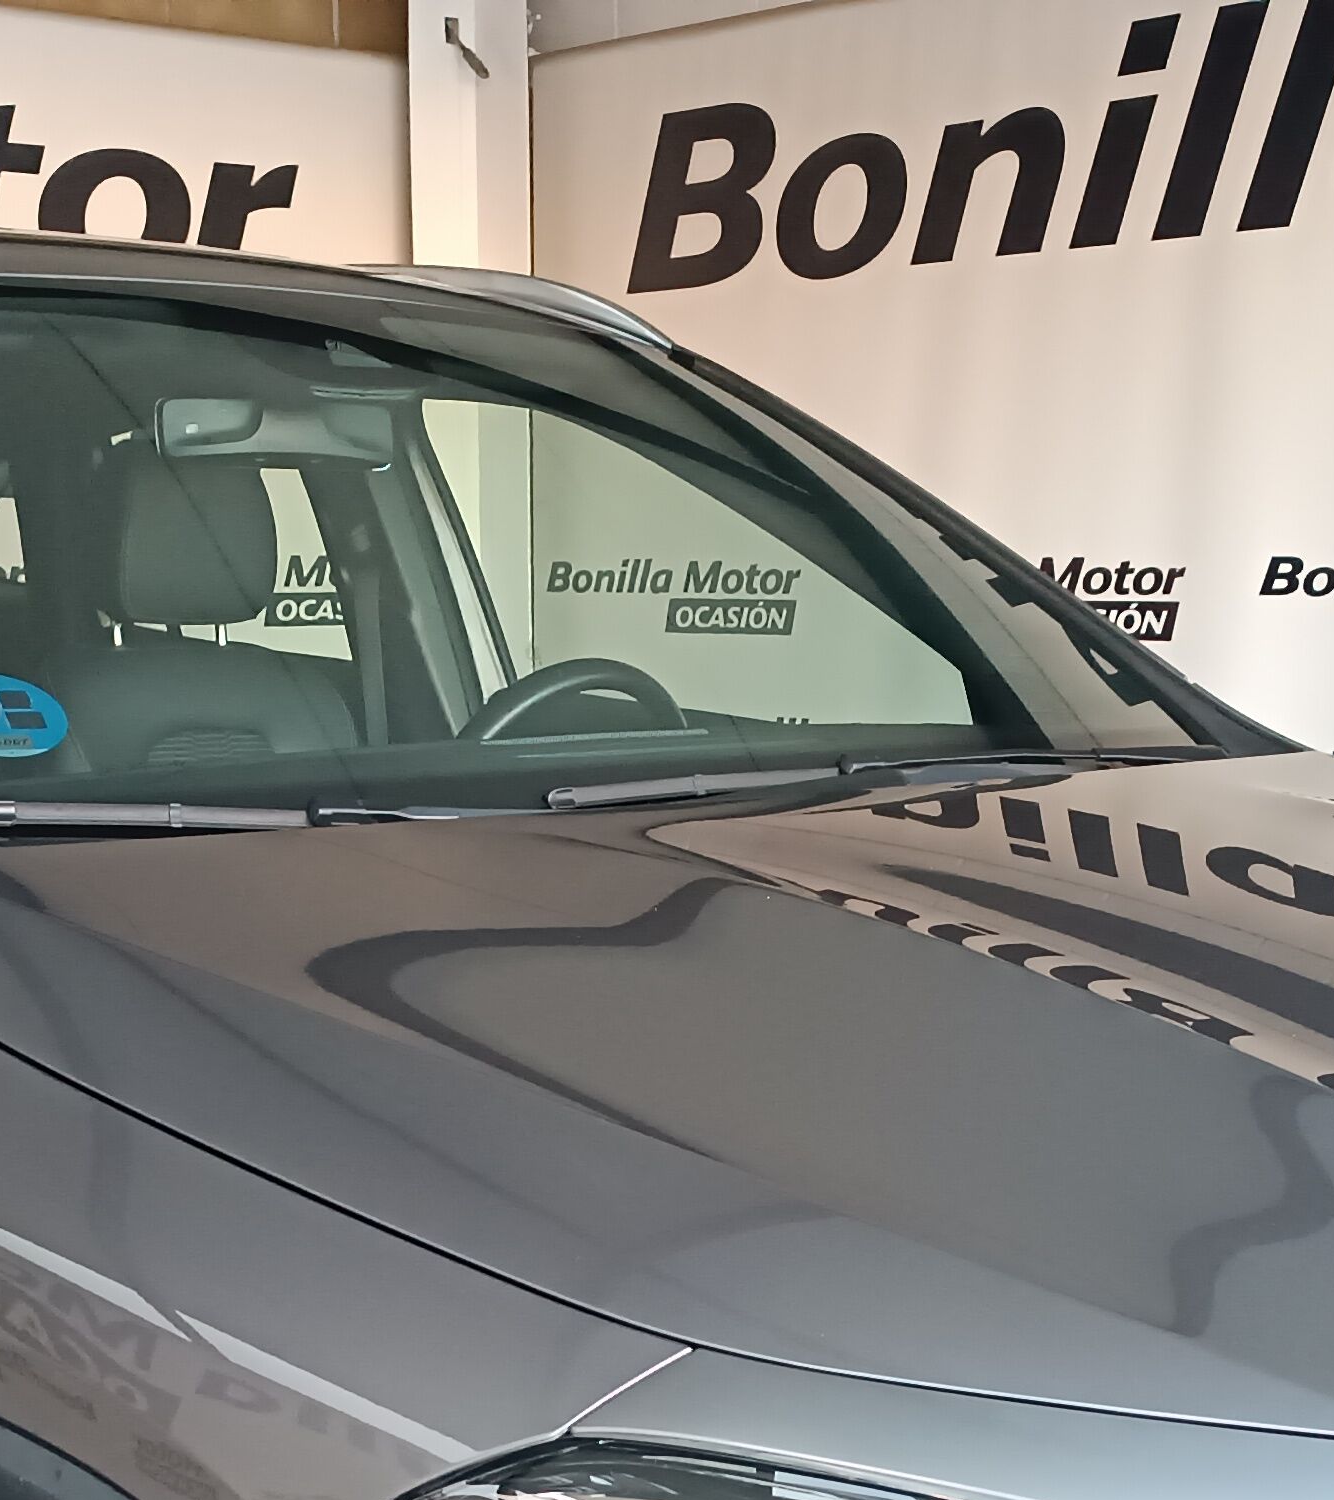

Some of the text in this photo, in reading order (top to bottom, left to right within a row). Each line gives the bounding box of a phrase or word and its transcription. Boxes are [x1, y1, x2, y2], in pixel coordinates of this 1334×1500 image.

[547, 559, 801, 594] Bonilla Motor
[1040, 556, 1186, 595] Motor
[675, 601, 787, 630] OCASIÓN
